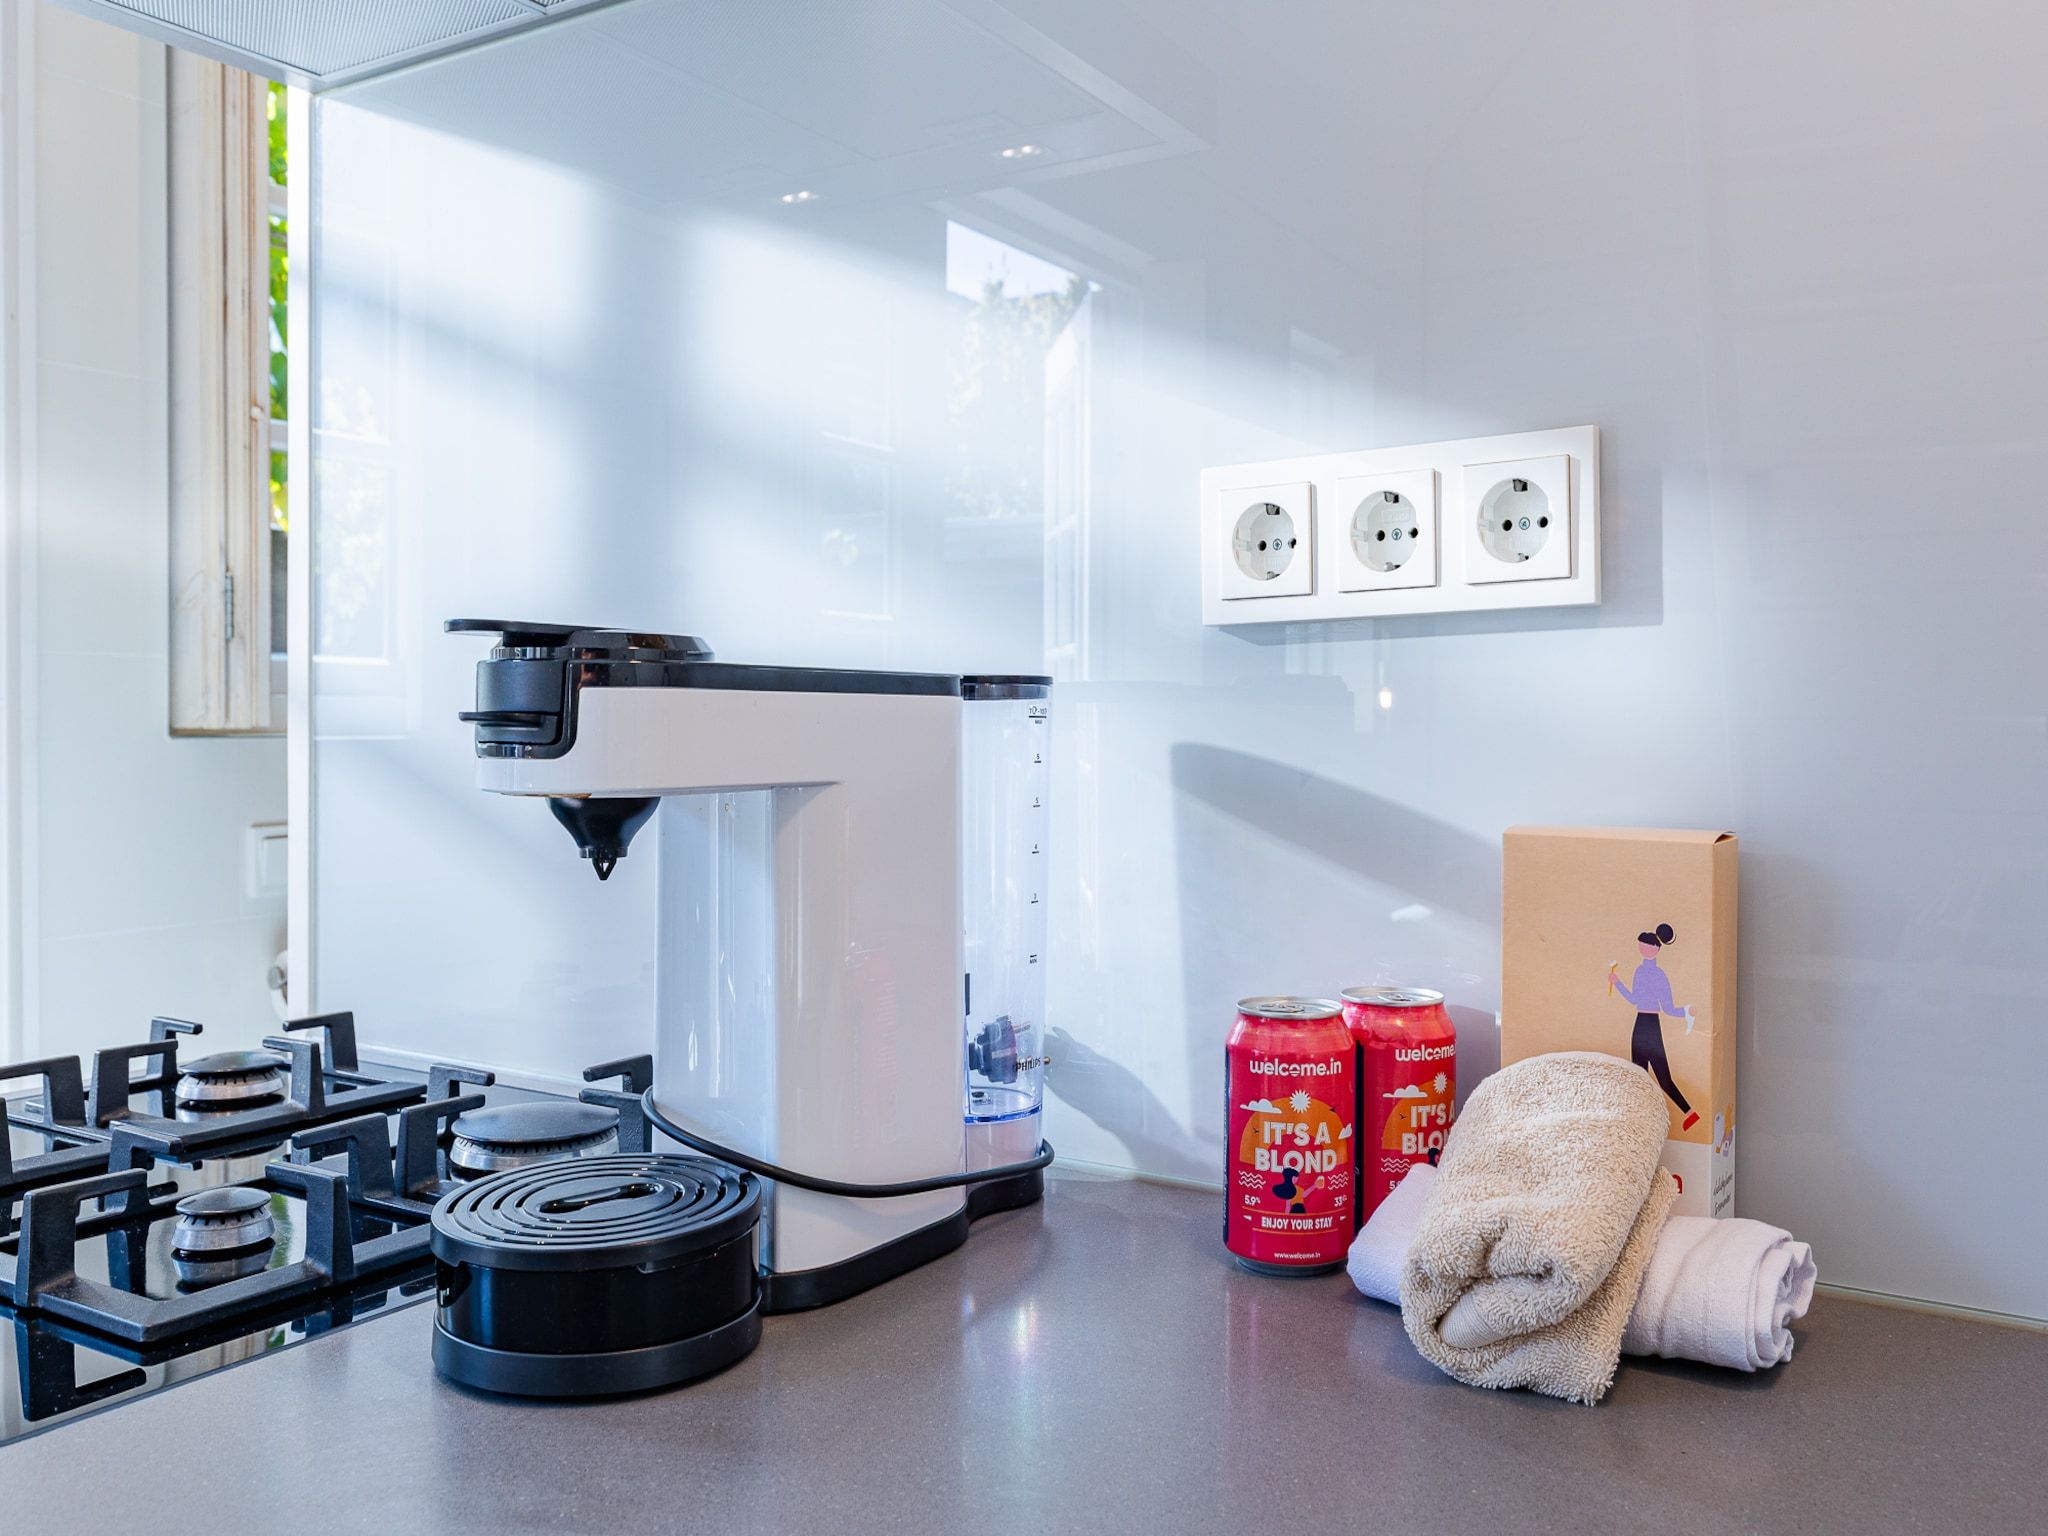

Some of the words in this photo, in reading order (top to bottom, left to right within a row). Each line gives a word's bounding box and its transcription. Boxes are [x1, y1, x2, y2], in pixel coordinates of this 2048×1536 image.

[1249, 1057, 1342, 1077] welcome.in
[1410, 1102, 1447, 1128] IT'S
[1263, 1121, 1311, 1147] IT'S
[1314, 1121, 1331, 1145] A
[1254, 1147, 1337, 1174] BLOND
[1261, 1216, 1288, 1230] ENJOY
[1290, 1218, 1313, 1230] YOUR
[1315, 1216, 1333, 1229] STAY
